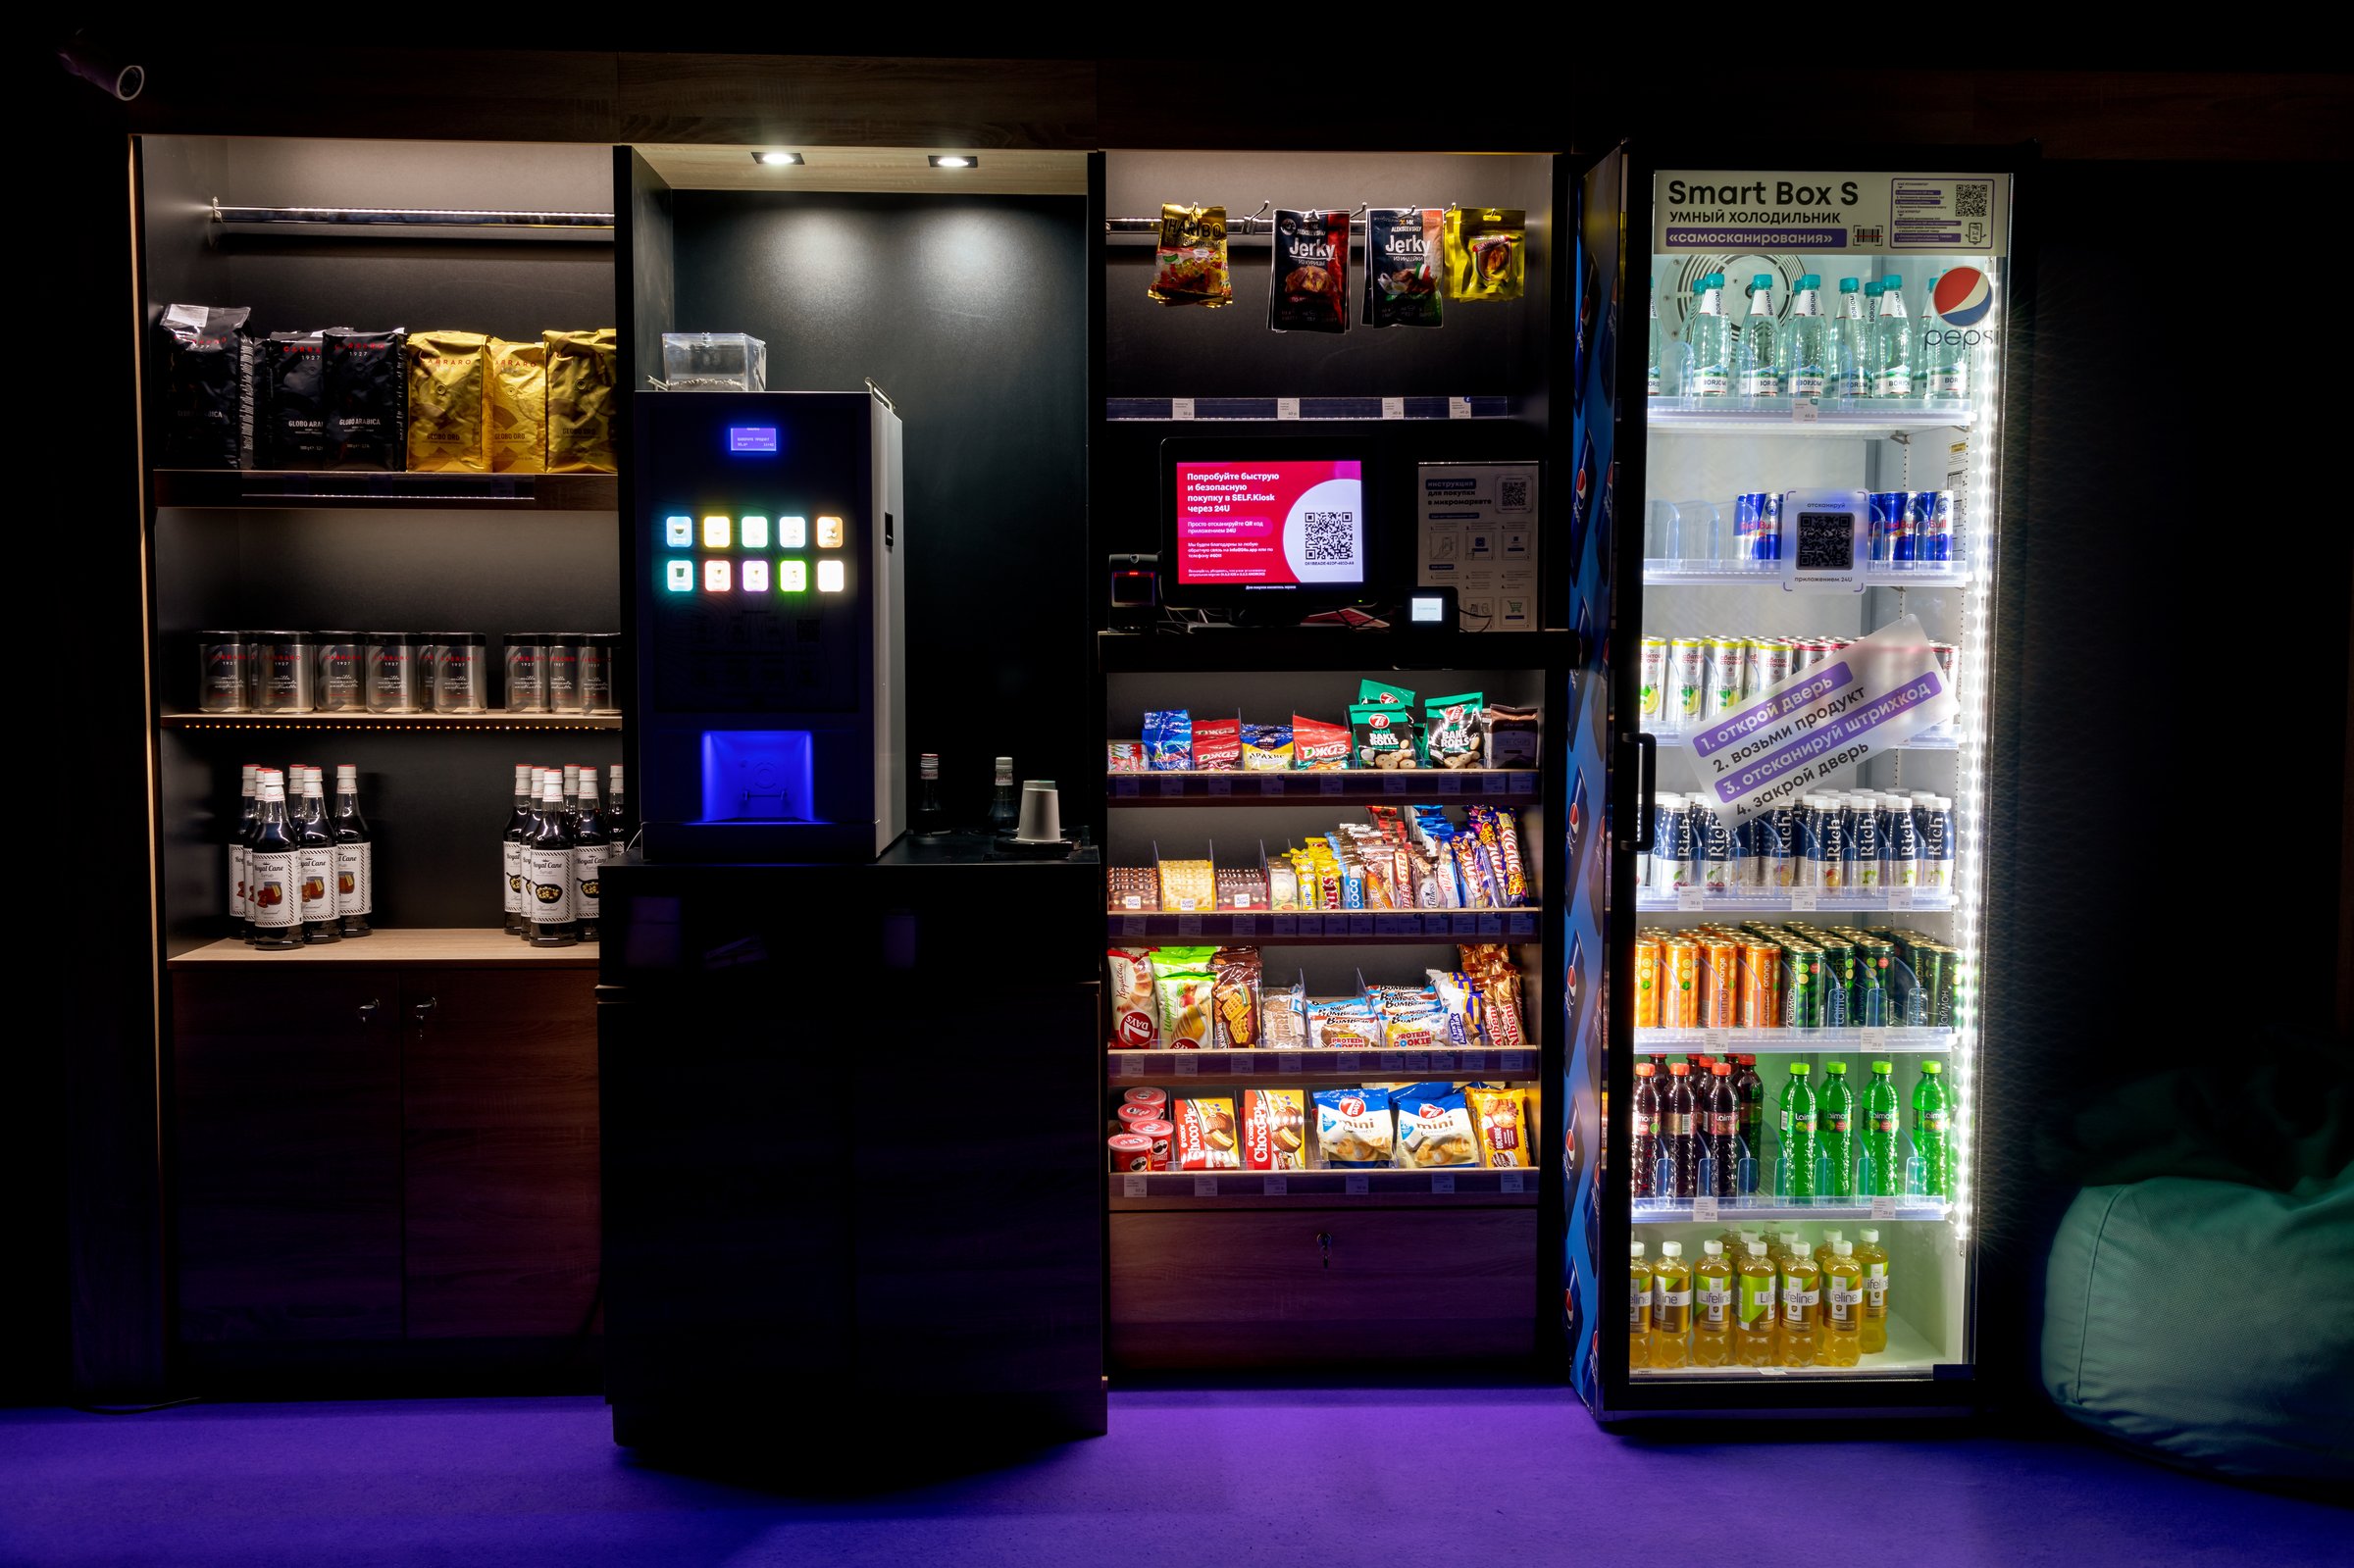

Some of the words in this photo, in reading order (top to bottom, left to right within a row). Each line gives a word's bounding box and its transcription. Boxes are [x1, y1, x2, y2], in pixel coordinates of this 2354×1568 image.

[1668, 179, 1766, 206] Smart
[1775, 181, 1832, 206] Box
[1840, 180, 1860, 206] S
[1168, 218, 1222, 238] HARIBO
[1385, 234, 1431, 257] Jerky
[1669, 231, 1834, 246] «самосканирования»
[1289, 236, 1336, 261] Jerky
[1187, 472, 1240, 482] Попробуйте
[1241, 472, 1280, 481] быструю
[1195, 482, 1248, 492] безопасную
[1187, 494, 1224, 503] покупку
[1807, 501, 1846, 510] отсканируй
[1759, 522, 1774, 531] Bull
[1927, 520, 1947, 530] Bull
[1794, 576, 1839, 584] приложением
[1700, 736, 1716, 751] 1.
[1715, 704, 1781, 744] открой
[1781, 675, 1834, 716] дверь
[1443, 729, 1468, 739] BAKE
[1712, 757, 1730, 774] 2.
[1730, 726, 1794, 765] возьми
[1793, 685, 1867, 734] продукт
[1721, 781, 1741, 796] 3.
[1741, 725, 1845, 786] отсканируй
[1845, 681, 1933, 734] штрихкод
[1735, 801, 1753, 817] 4.
[1752, 767, 1817, 809] закрой
[1817, 740, 1870, 778] дверь
[1677, 818, 1691, 857] Rich
[1710, 817, 1724, 857] Rich
[1826, 818, 1840, 858] Rich
[1861, 817, 1874, 857] Rich
[1901, 817, 1915, 857] Rich
[1927, 816, 1942, 856] Rich
[268, 863, 283, 872] Cane
[311, 859, 327, 868] Cane
[1398, 854, 1407, 879] STEP
[1349, 879, 1360, 909] COCO
[1401, 884, 1411, 909] UPER
[1718, 957, 1727, 985] orange
[1489, 1005, 1503, 1046] Albeni
[1505, 1004, 1520, 1046] Albeni
[1393, 1037, 1432, 1047] COOKIE
[1396, 1031, 1431, 1040] PROTEIN
[1338, 1118, 1374, 1129] mini
[1416, 1115, 1454, 1130] mini
[1631, 1292, 1650, 1306] eline
[1656, 1293, 1678, 1305] eline
[1760, 1290, 1775, 1305] Life
[1781, 1291, 1815, 1305] Lifeline
[1832, 1291, 1859, 1305] feline
